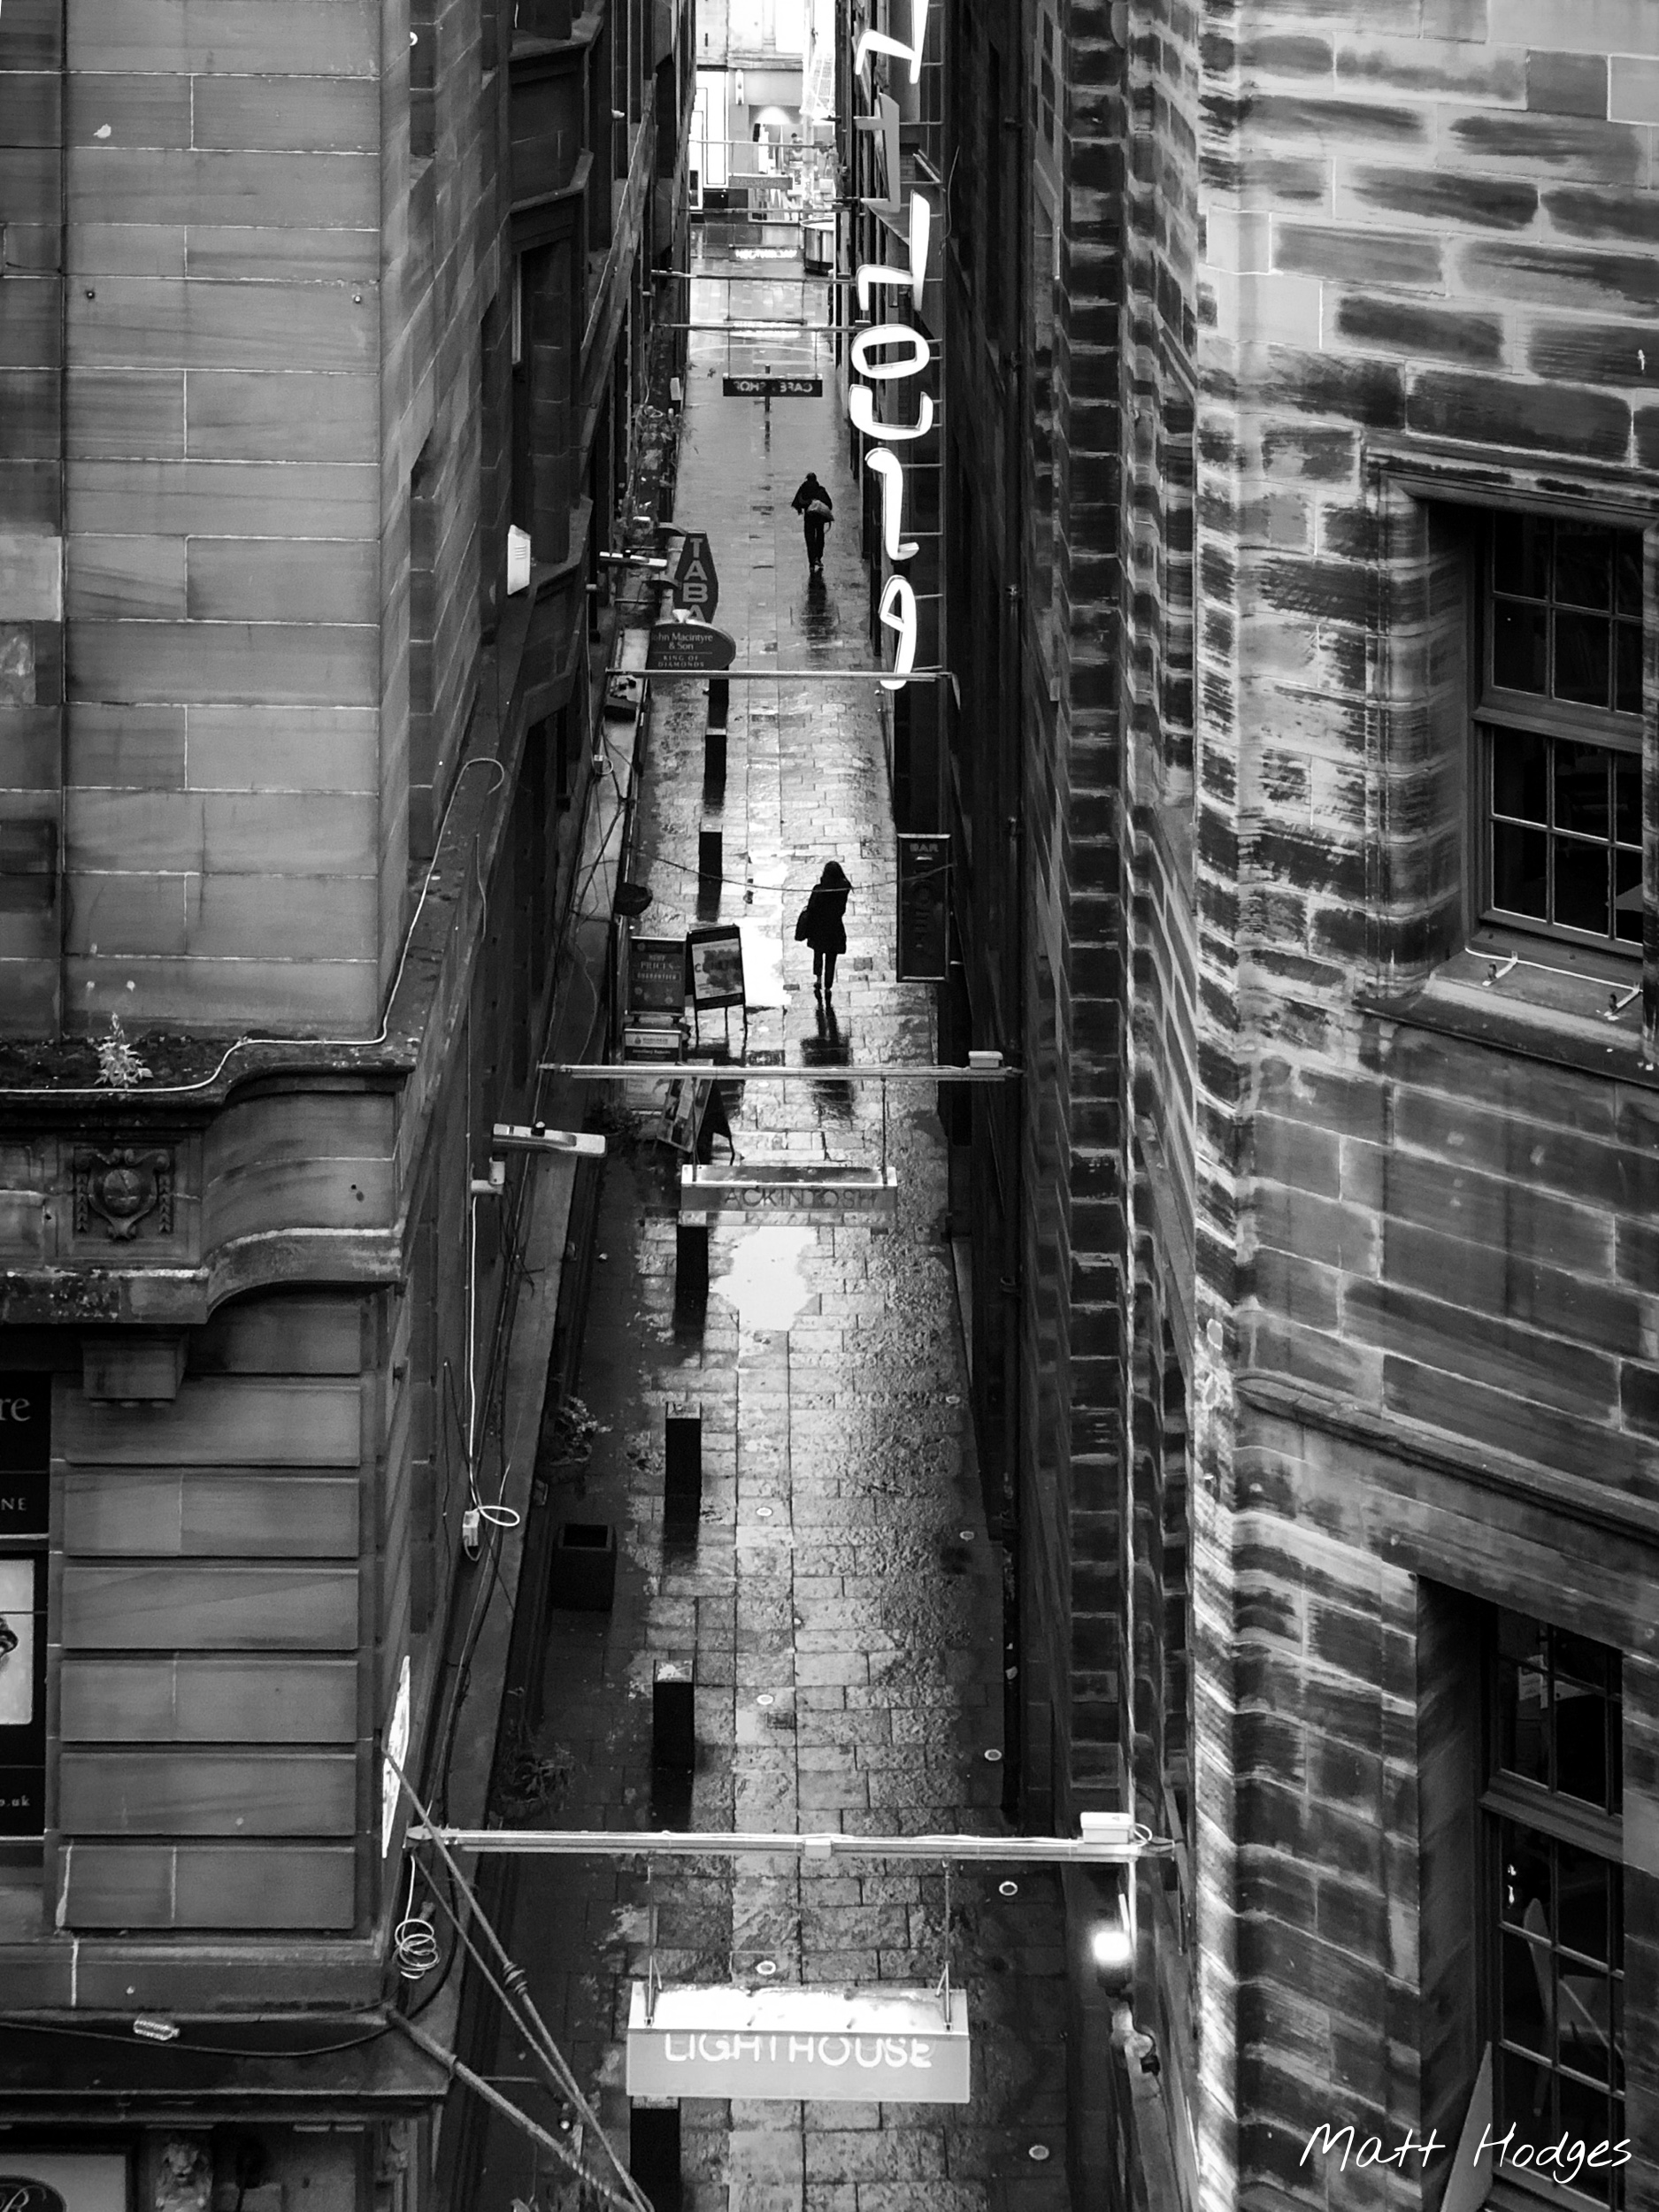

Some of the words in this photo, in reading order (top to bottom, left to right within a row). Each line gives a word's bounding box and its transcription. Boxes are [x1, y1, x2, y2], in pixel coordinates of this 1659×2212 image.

[672, 632, 713, 644] Macintyre
[668, 641, 675, 650] &
[677, 641, 695, 650] Son
[910, 842, 939, 853] BAR
[724, 1187, 878, 1209] ACKINTOSH
